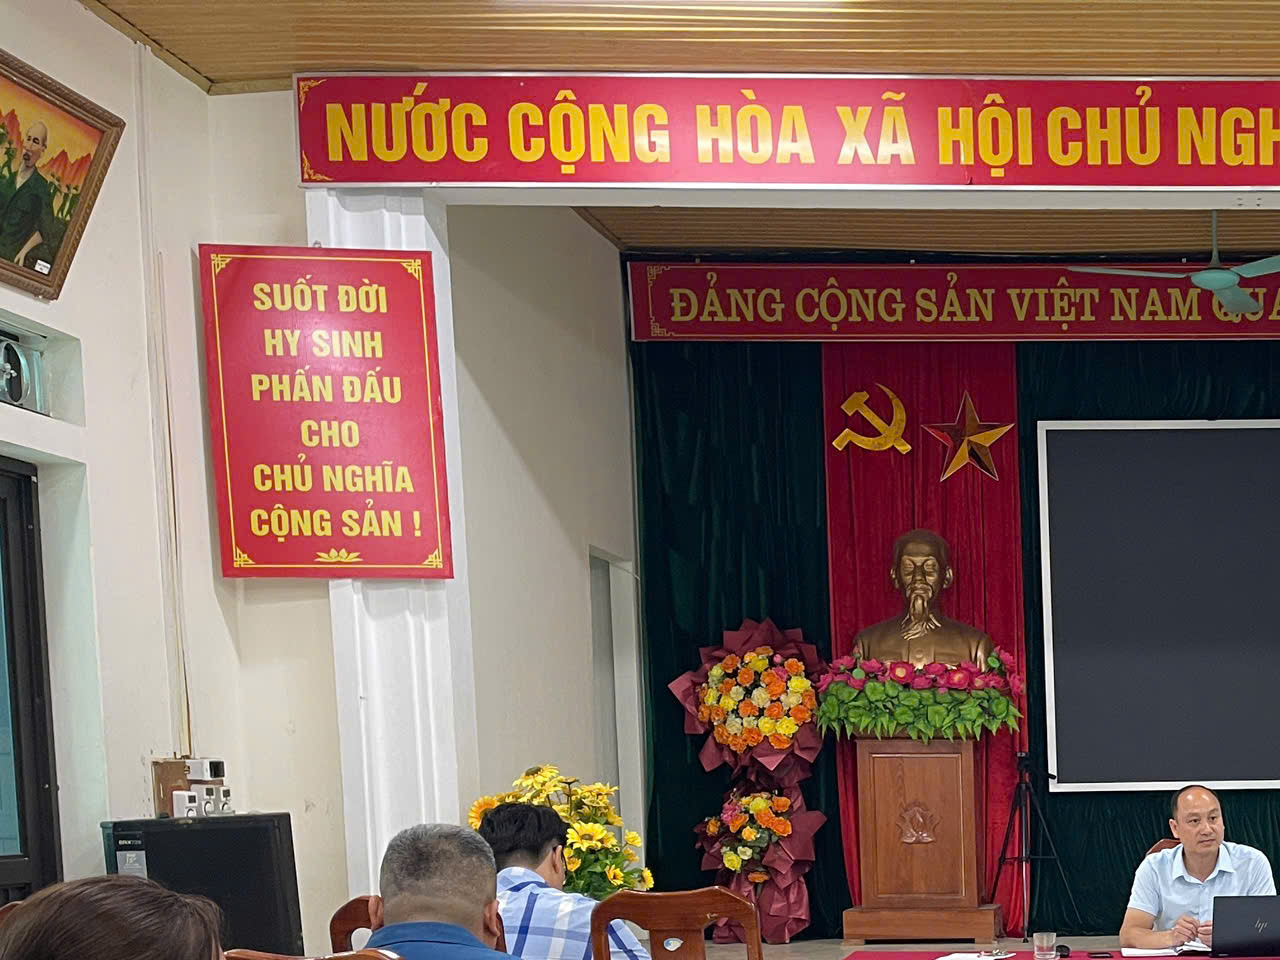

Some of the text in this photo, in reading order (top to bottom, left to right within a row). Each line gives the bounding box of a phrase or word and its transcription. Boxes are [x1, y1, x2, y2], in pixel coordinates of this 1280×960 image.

[326, 83, 488, 162] NƯỚC
[508, 90, 670, 174] CỘNG
[696, 89, 816, 165] HÒA
[836, 91, 916, 165] XÃ
[938, 93, 1032, 177] HỘI
[1048, 86, 1160, 166] CHỦ
[253, 274, 387, 314] SUỐT ĐỜI
[672, 272, 784, 322] ĐẢNG
[796, 278, 904, 332] CỘNG
[916, 272, 992, 322] SẢN
[1008, 276, 1099, 330] VIỆT
[1112, 288, 1201, 320] NAM
[264, 328, 384, 359] HY SINH
[251, 365, 402, 404] PHẤN ĐẤU
[301, 419, 360, 448] CHO
[254, 453, 414, 494] CHỦ NGHĨA
[251, 499, 422, 542] CỘNG SẢN !
[1254, 918, 1268, 934] hp
